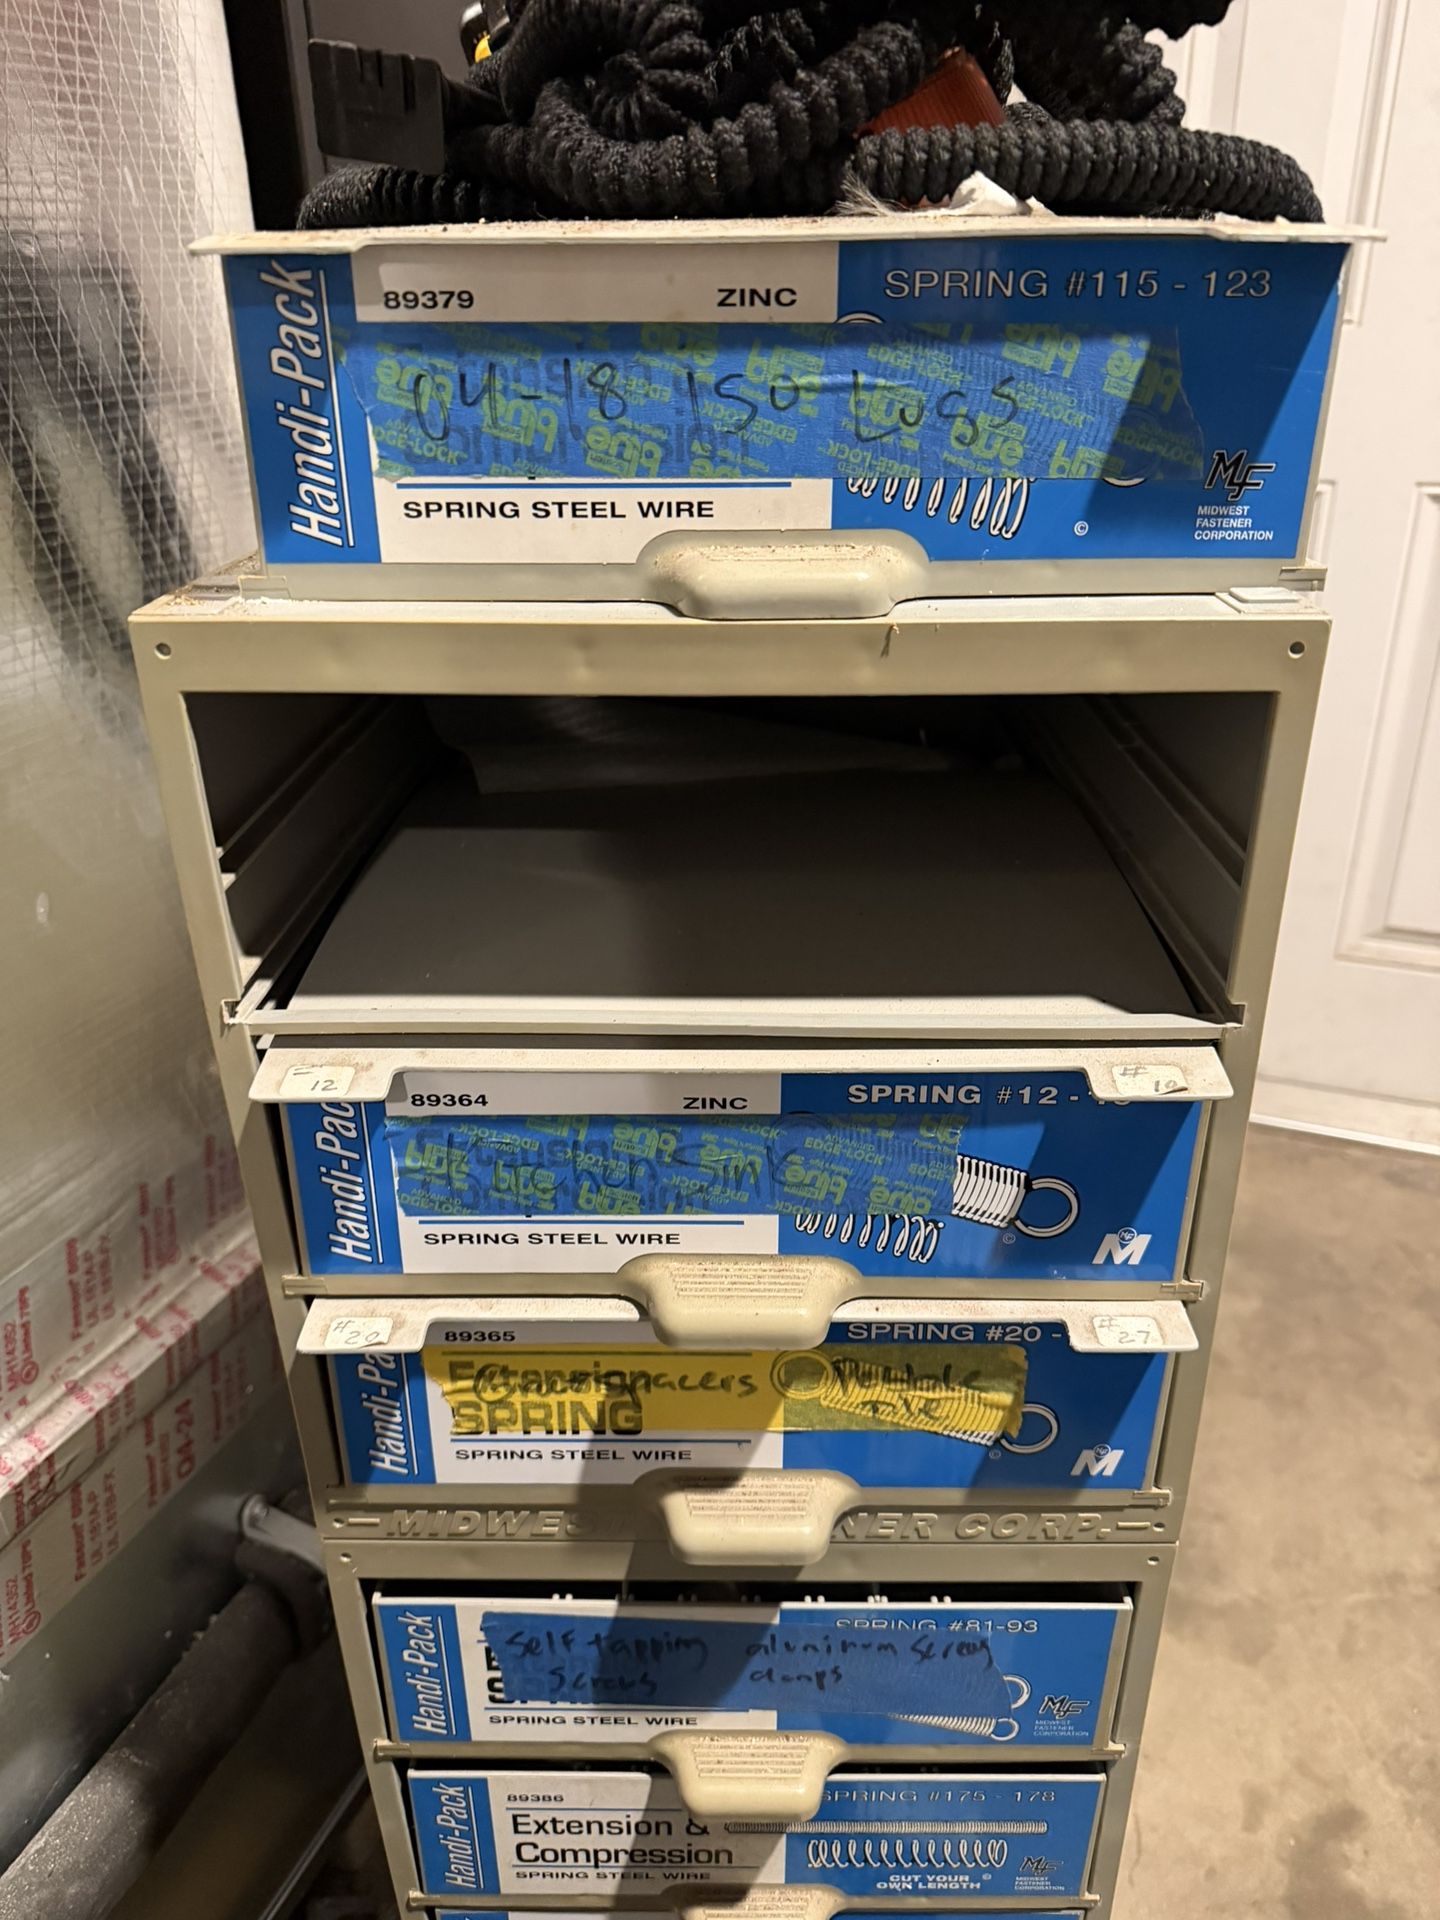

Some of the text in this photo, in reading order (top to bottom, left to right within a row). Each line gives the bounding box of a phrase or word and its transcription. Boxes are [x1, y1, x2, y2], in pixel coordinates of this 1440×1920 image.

[884, 269, 1049, 298] SPRING
[1066, 270, 1160, 298] #115
[1206, 270, 1272, 298] 123
[383, 287, 798, 310] 89379 ZINC
[259, 261, 344, 549] Handi-Pack
[403, 500, 715, 519] SPRING STEEL WIRE
[1197, 505, 1250, 516] MIDWEST
[1196, 517, 1253, 528] FASTENER
[1194, 530, 1274, 540] CORPORATION
[410, 1094, 749, 1110] 89364 ZINC
[848, 1085, 981, 1104] SPRING
[997, 1085, 1058, 1105] #12
[315, 1102, 373, 1264] Handi-Pac
[424, 1233, 681, 1246] SPRING STEEL WIRE
[444, 1331, 516, 1342] 89365
[847, 1323, 974, 1341] SPRING
[986, 1326, 1041, 1342] #20
[1118, 1331, 1150, 1345] 27
[356, 1353, 408, 1476] Handi-Pa
[450, 1400, 643, 1436] SPRING
[455, 1449, 692, 1461] SPRING STEEL WIRE
[951, 1619, 1038, 1633] #81-93
[397, 1611, 447, 1735] Handi-Pack
[489, 1715, 698, 1726] SPRING STEEL WIRE
[820, 1791, 917, 1802] SPRING
[1015, 1791, 1056, 1802] 178
[512, 1814, 710, 1836] Extension &
[432, 1783, 478, 1888] Handi-Pack
[515, 1842, 734, 1869] Compression
[516, 1871, 711, 1880] SPRING STEEL WIRE
[889, 1874, 970, 1882] CUT YOUR
[877, 1881, 981, 1890] OWN LENGTH
